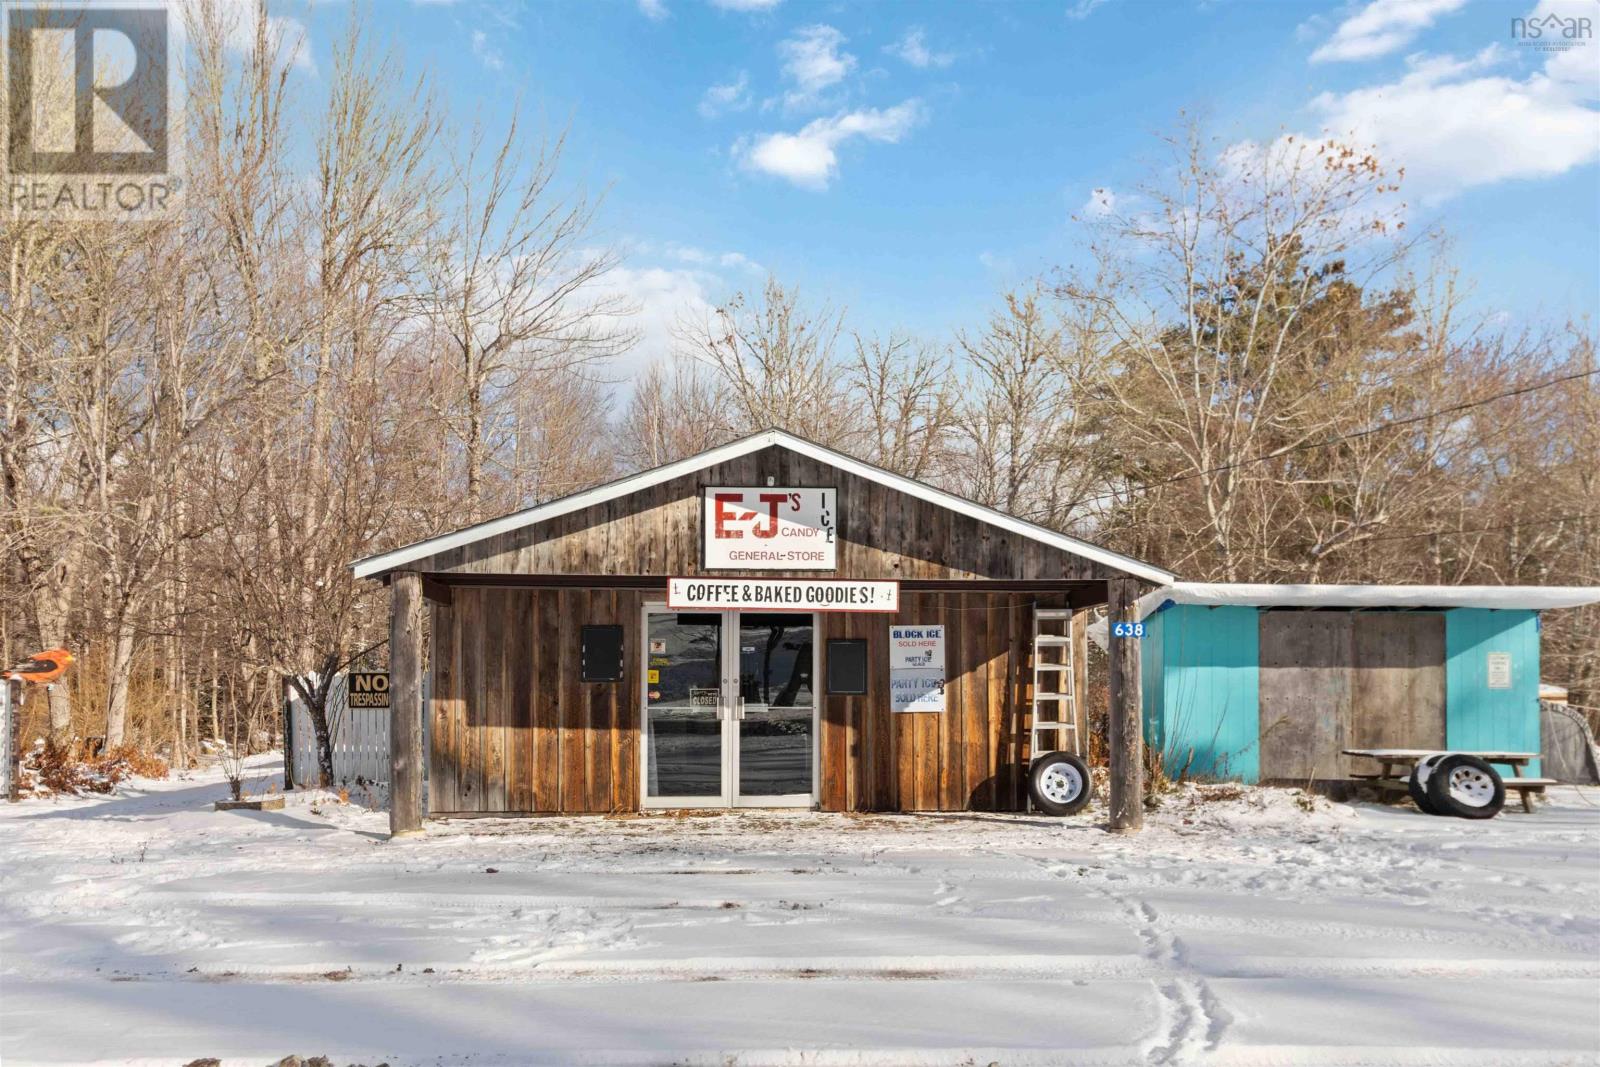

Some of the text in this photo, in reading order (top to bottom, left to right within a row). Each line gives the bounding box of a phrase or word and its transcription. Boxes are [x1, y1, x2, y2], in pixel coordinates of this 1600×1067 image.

[781, 527, 819, 537] CANDY
[687, 584, 875, 604] COFFEE & BAKED GOODIES!
[893, 629, 942, 639] BLOCK ICE
[1115, 623, 1143, 636] 638
[355, 675, 389, 692] NO
[692, 696, 717, 705] CLOSED
